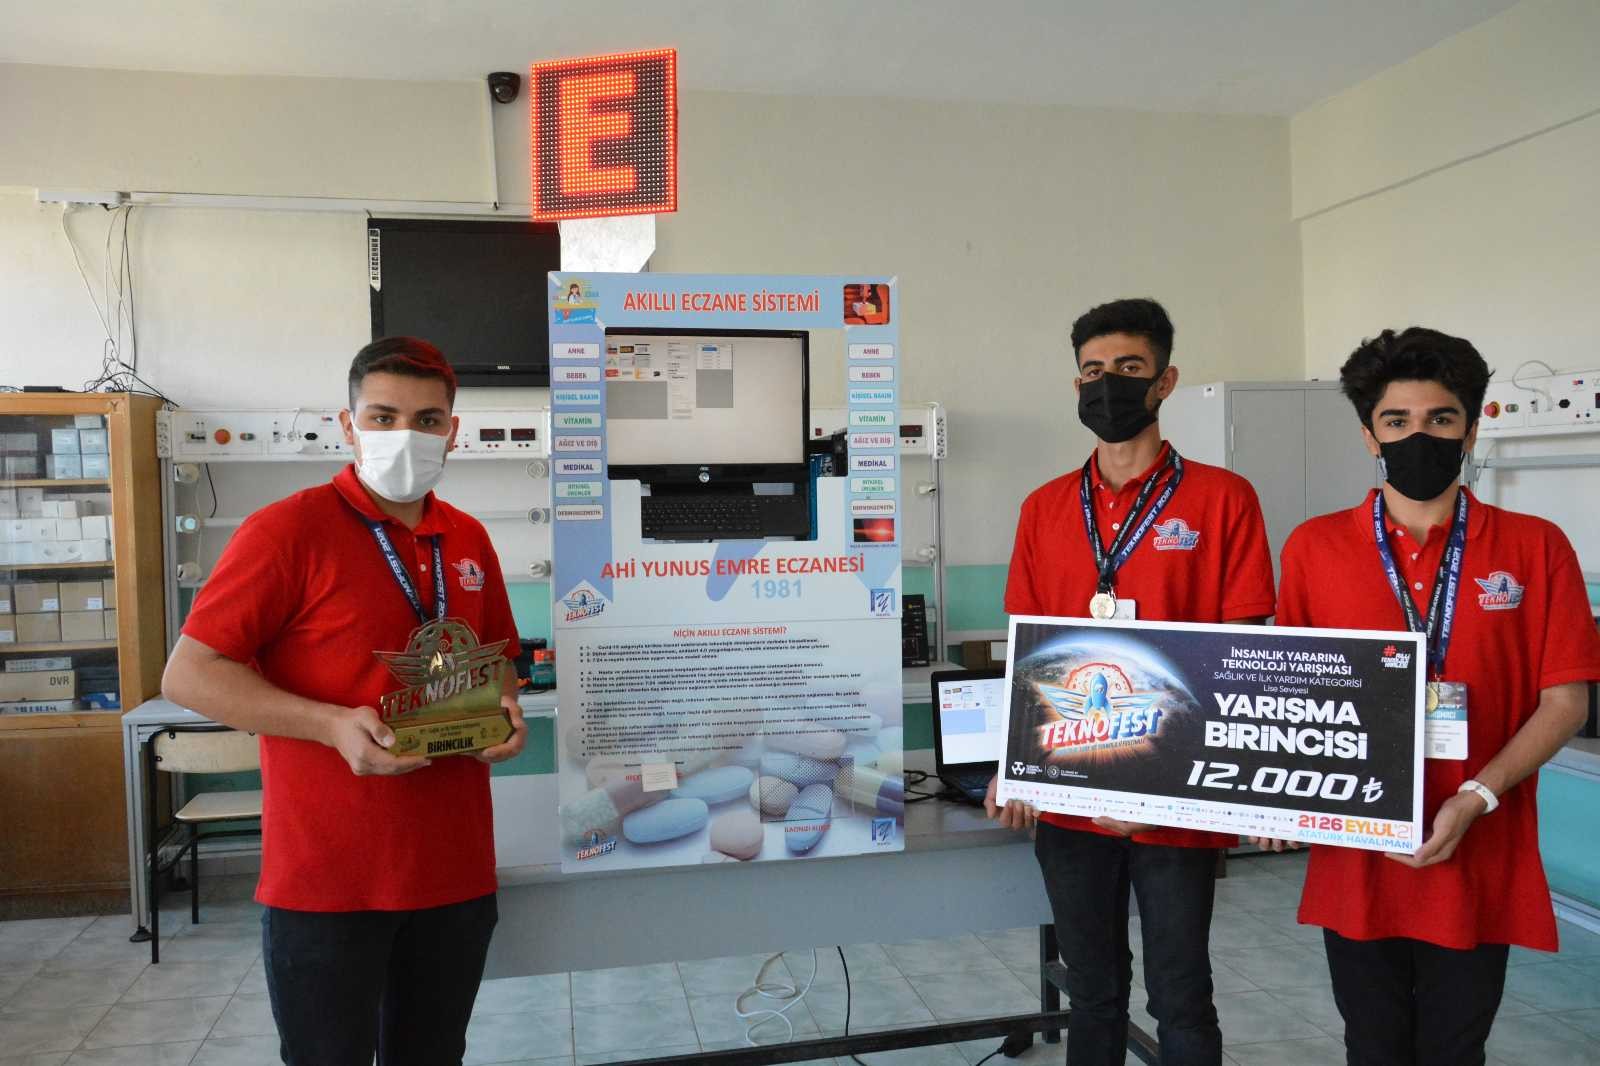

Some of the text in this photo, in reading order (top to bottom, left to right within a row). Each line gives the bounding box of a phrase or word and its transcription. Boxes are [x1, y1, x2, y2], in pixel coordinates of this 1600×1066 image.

[561, 70, 637, 194] E
[623, 288, 820, 313] AKILLI ECZANE SİSTEMİ
[563, 415, 592, 426] VİTAMİN
[858, 413, 886, 424] VİTAMİN
[563, 462, 594, 472] MEDİKAL
[857, 458, 887, 468] MEDİKAL
[1122, 510, 1158, 557] TEKNOFEST
[1158, 487, 1173, 508] 2021
[601, 553, 865, 578] AHİ YUNUS EMRE ECZANESİ
[752, 580, 802, 599] 1981
[1442, 573, 1457, 639] TEKNOFEST
[1451, 546, 1462, 573] 2021
[673, 629, 695, 639] NİÇİN
[722, 627, 751, 637] ECZANE
[1231, 646, 1346, 664] İNSANLIK YARARINA
[1221, 658, 1352, 676] TEKNOLOJİ YARIŞMASI
[49, 675, 70, 686] DVR
[1214, 670, 1363, 689] SAĞLIK VE İLK YARDIM KATEGORİSİ
[380, 660, 502, 719] TEKNOFEST
[1263, 685, 1309, 695] Lise Seviyesi
[1213, 692, 1361, 726] YARIŞMA
[1041, 708, 1163, 750] TEKNOFEST
[427, 735, 474, 754] BİRİNCİLİK
[1204, 720, 1368, 760] BİRİNCİSİ
[1186, 760, 1359, 801] 12.000
[575, 840, 617, 860] TEKNOFEST
